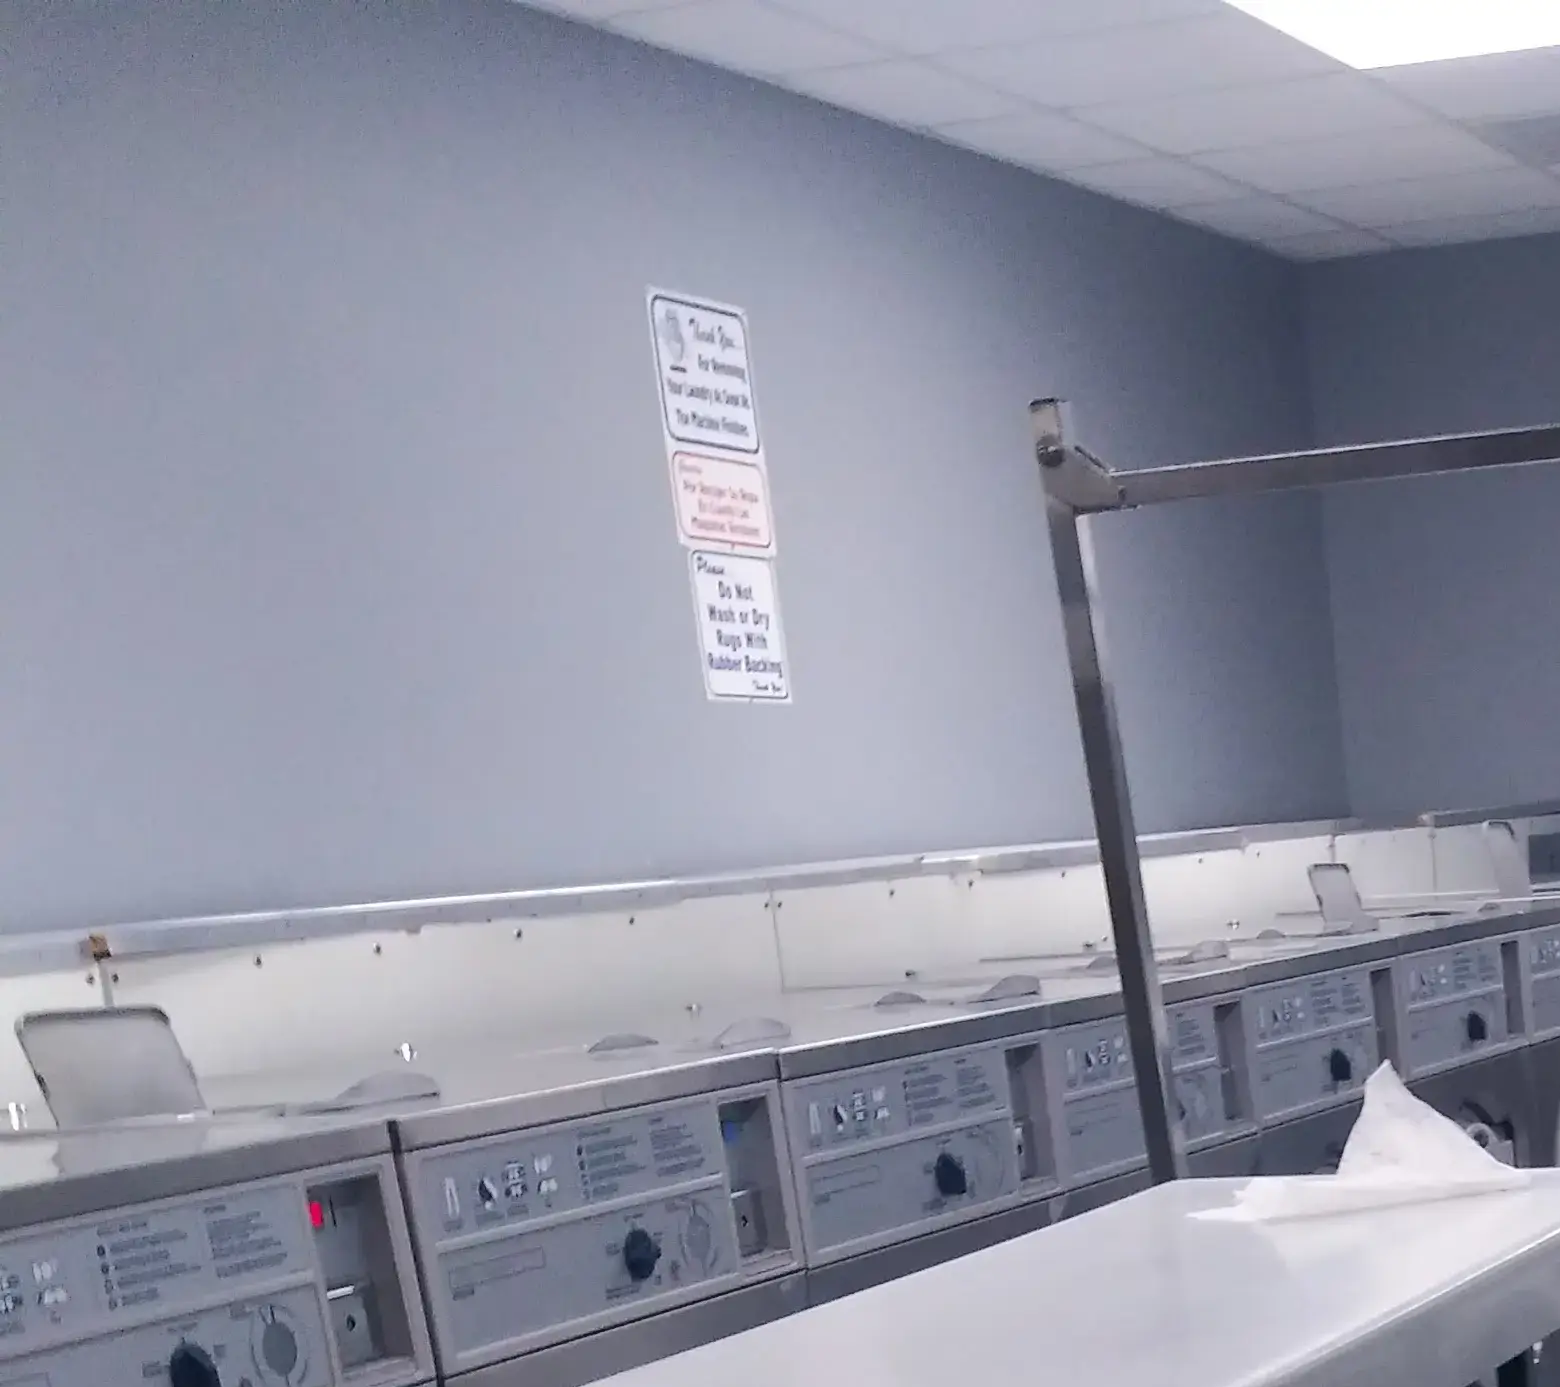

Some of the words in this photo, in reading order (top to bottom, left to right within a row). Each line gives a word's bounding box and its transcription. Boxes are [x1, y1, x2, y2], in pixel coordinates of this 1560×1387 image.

[717, 580, 733, 600] Do
[735, 583, 754, 601] Not
[707, 604, 736, 623] Wash
[739, 611, 749, 625] or
[751, 608, 770, 632] Dry
[716, 629, 742, 652] Rugs
[744, 632, 768, 650] With
[708, 652, 742, 672] Rubber
[744, 654, 784, 679] Backing
